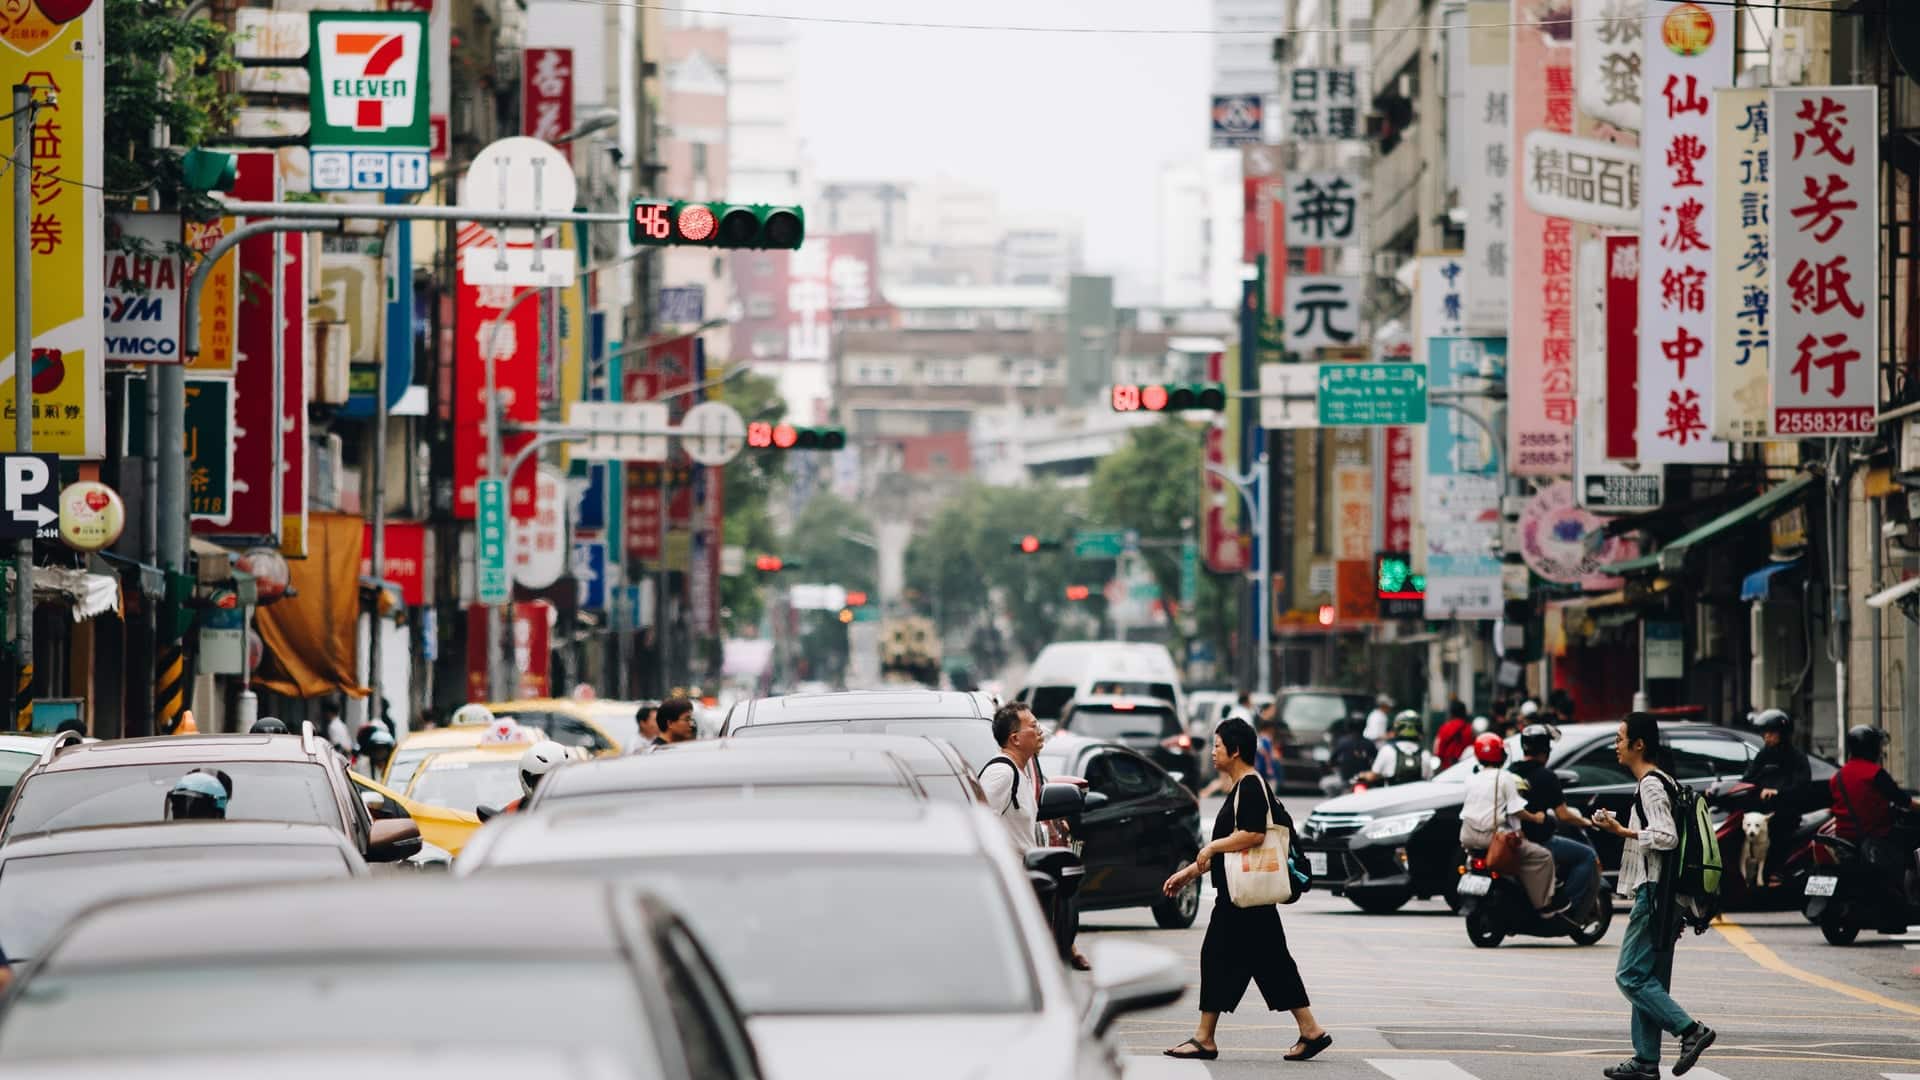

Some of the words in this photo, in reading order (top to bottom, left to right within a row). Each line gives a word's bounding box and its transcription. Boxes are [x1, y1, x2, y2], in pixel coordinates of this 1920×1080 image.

[336, 34, 403, 126] 7
[635, 204, 670, 239] 46
[1291, 177, 1356, 239] 菊
[103, 256, 176, 290] AHA
[1659, 73, 1711, 446] 仙豐濃縮中藥
[1787, 97, 1864, 399] 茂芳紙行
[1295, 283, 1353, 342] 元
[104, 336, 177, 355] YMCO
[1779, 412, 1871, 433] 25583216
[5, 456, 50, 511] P
[36, 528, 59, 539] 24H
